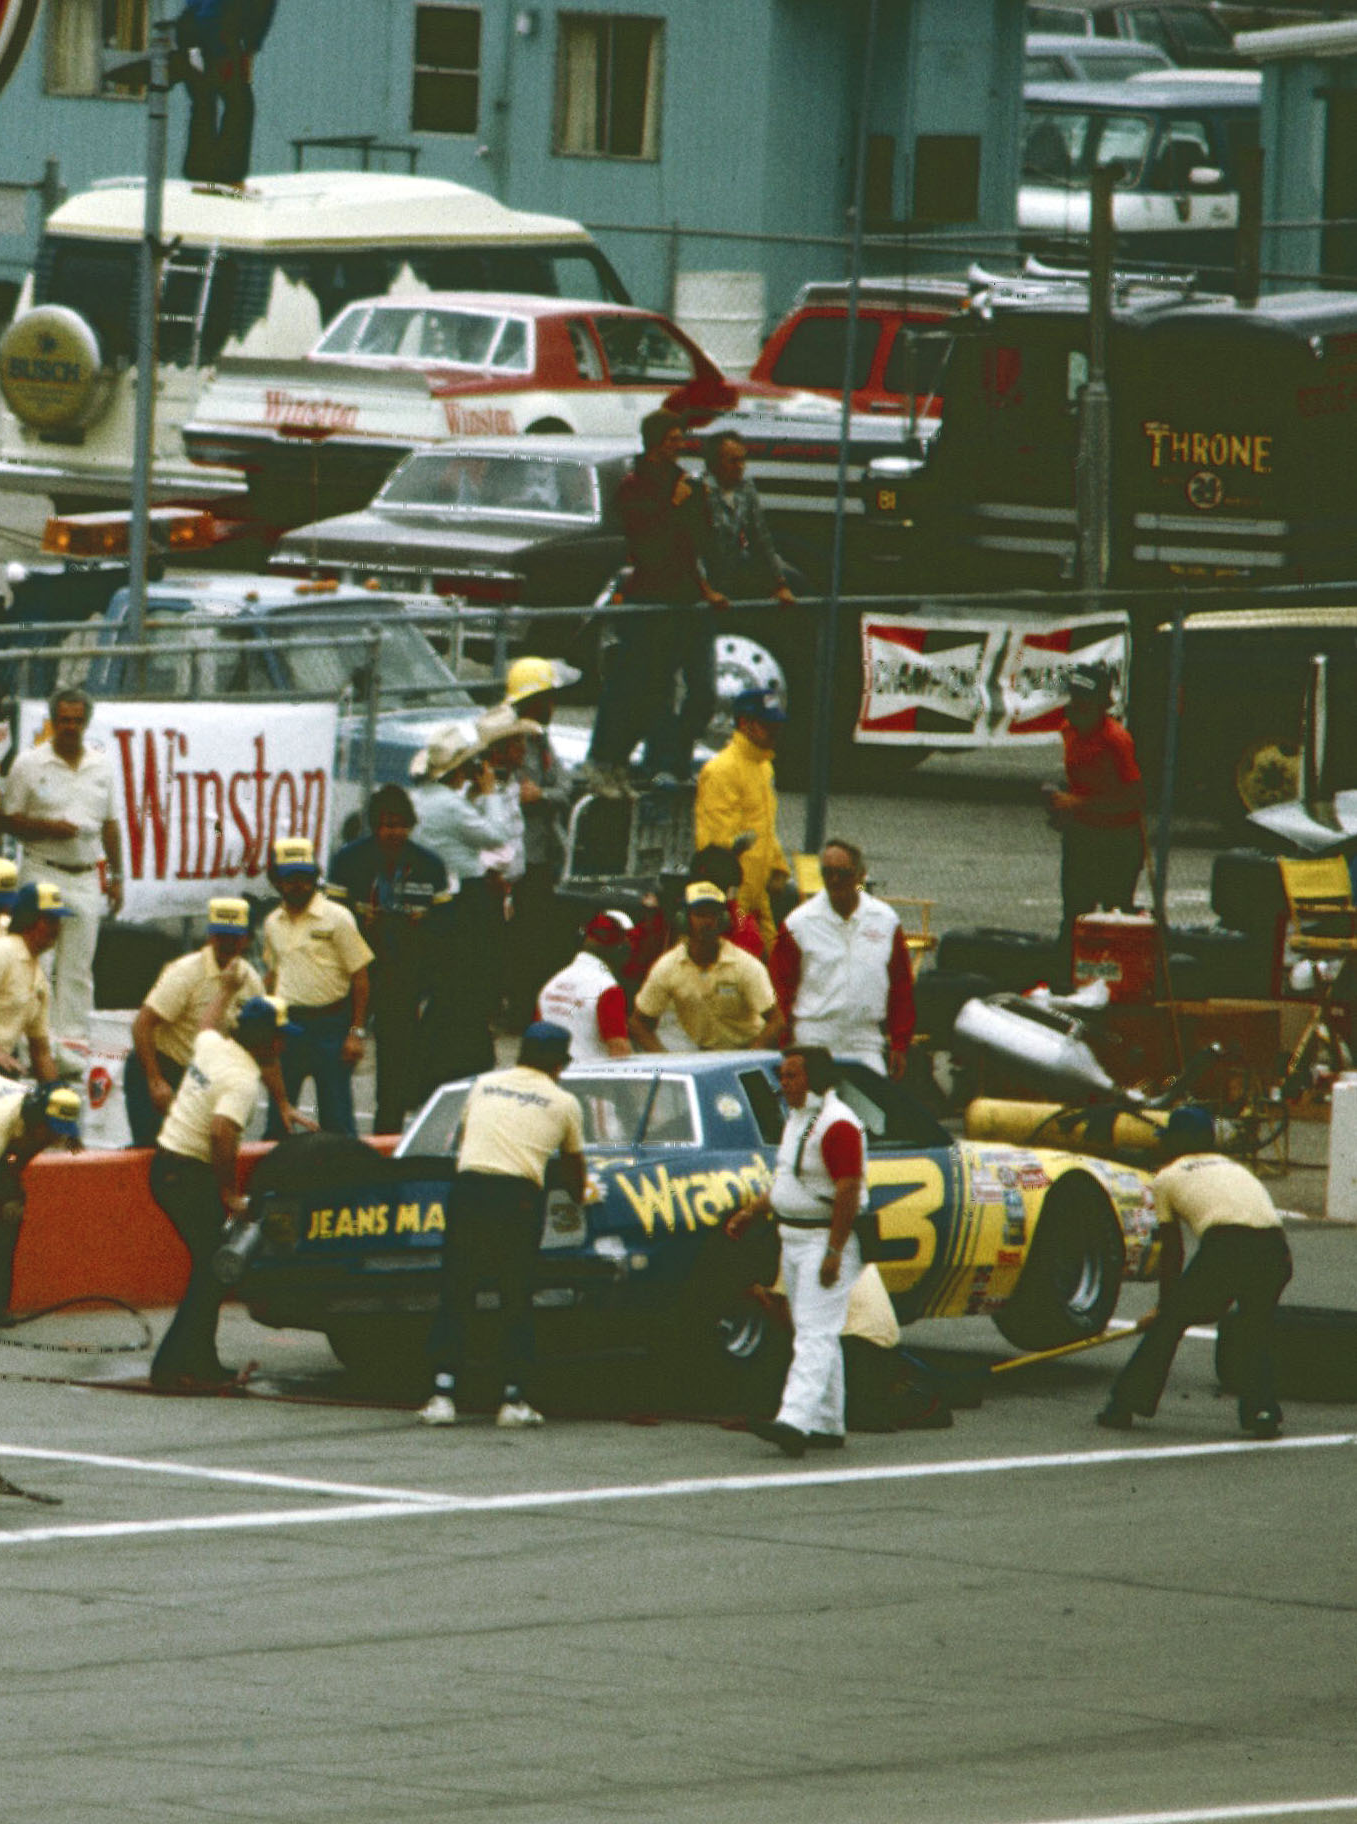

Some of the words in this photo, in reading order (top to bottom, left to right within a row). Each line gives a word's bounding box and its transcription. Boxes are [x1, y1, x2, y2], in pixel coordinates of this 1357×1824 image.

[8, 357, 80, 382] BUSCH
[266, 390, 359, 428] Winston
[444, 402, 518, 436] Winston
[1145, 425, 1273, 473] THRONE
[113, 728, 325, 879] Winston
[307, 1204, 389, 1239] JEANS
